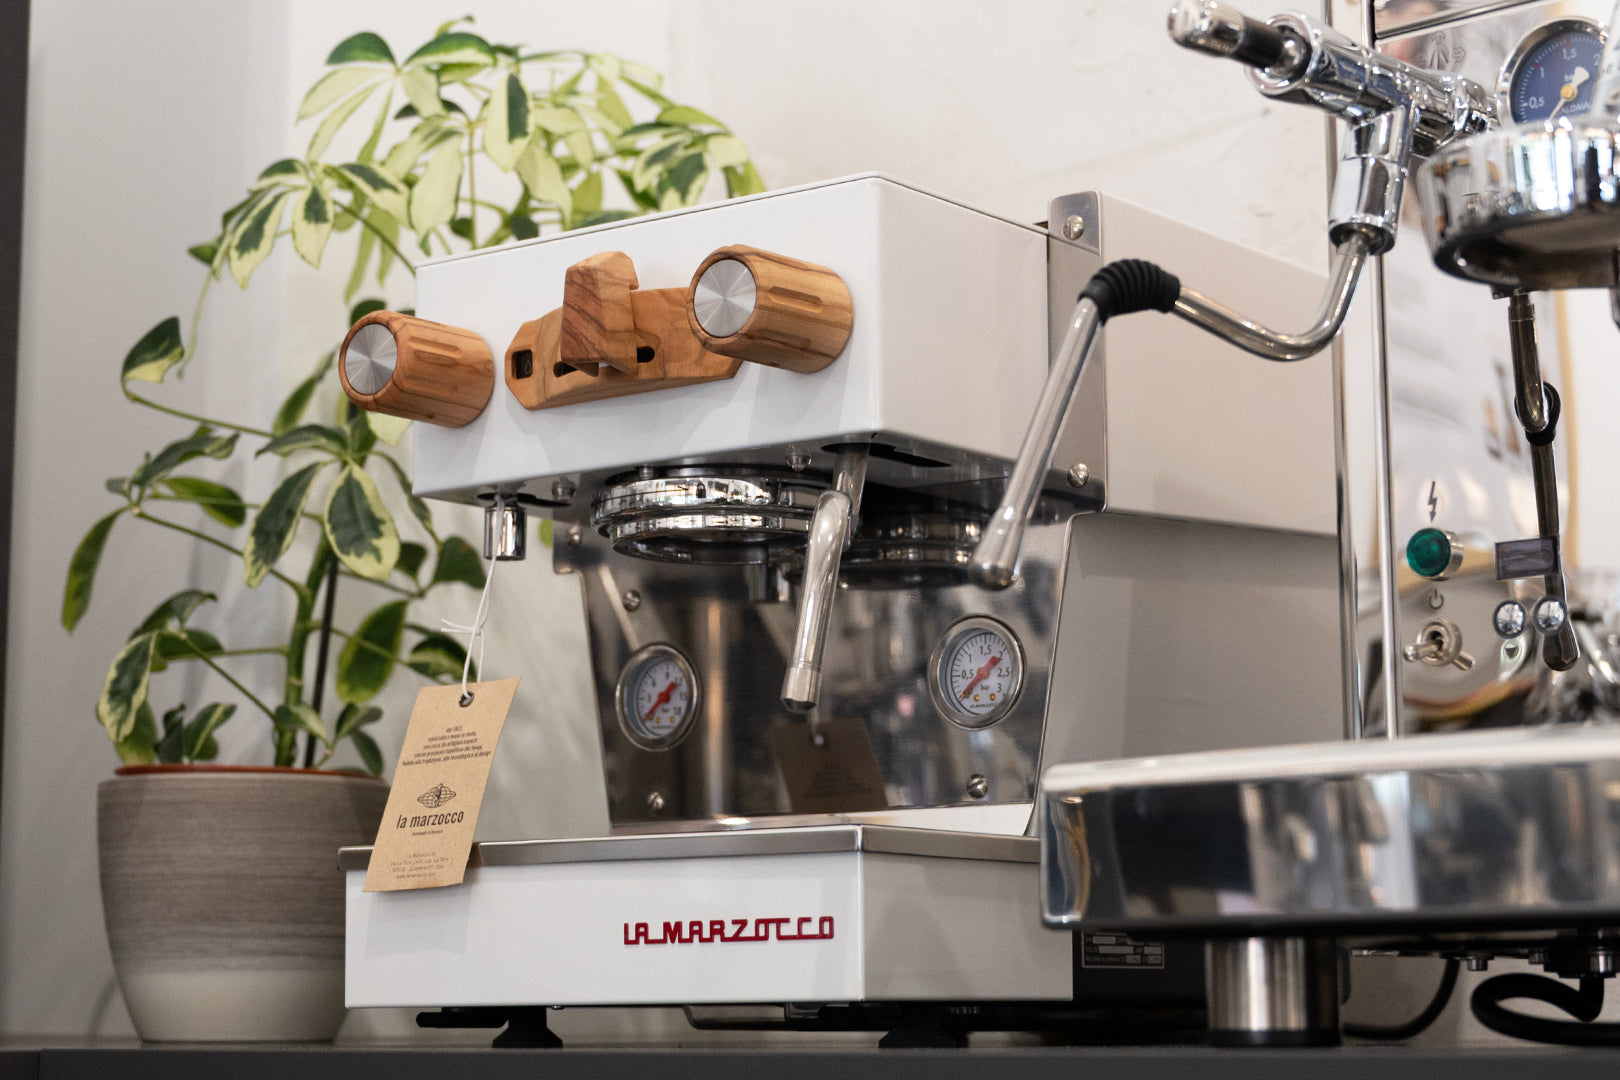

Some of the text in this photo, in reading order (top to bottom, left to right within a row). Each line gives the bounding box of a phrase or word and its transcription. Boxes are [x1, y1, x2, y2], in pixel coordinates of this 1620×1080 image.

[1528, 97, 1545, 109] 0,5
[979, 645, 992, 656] 1,5
[961, 669, 974, 680] 0,5
[997, 667, 1010, 679] 2,5
[997, 682, 1002, 693] 3
[396, 811, 464, 829] la marzocco
[663, 916, 834, 944] MARZOCCO
